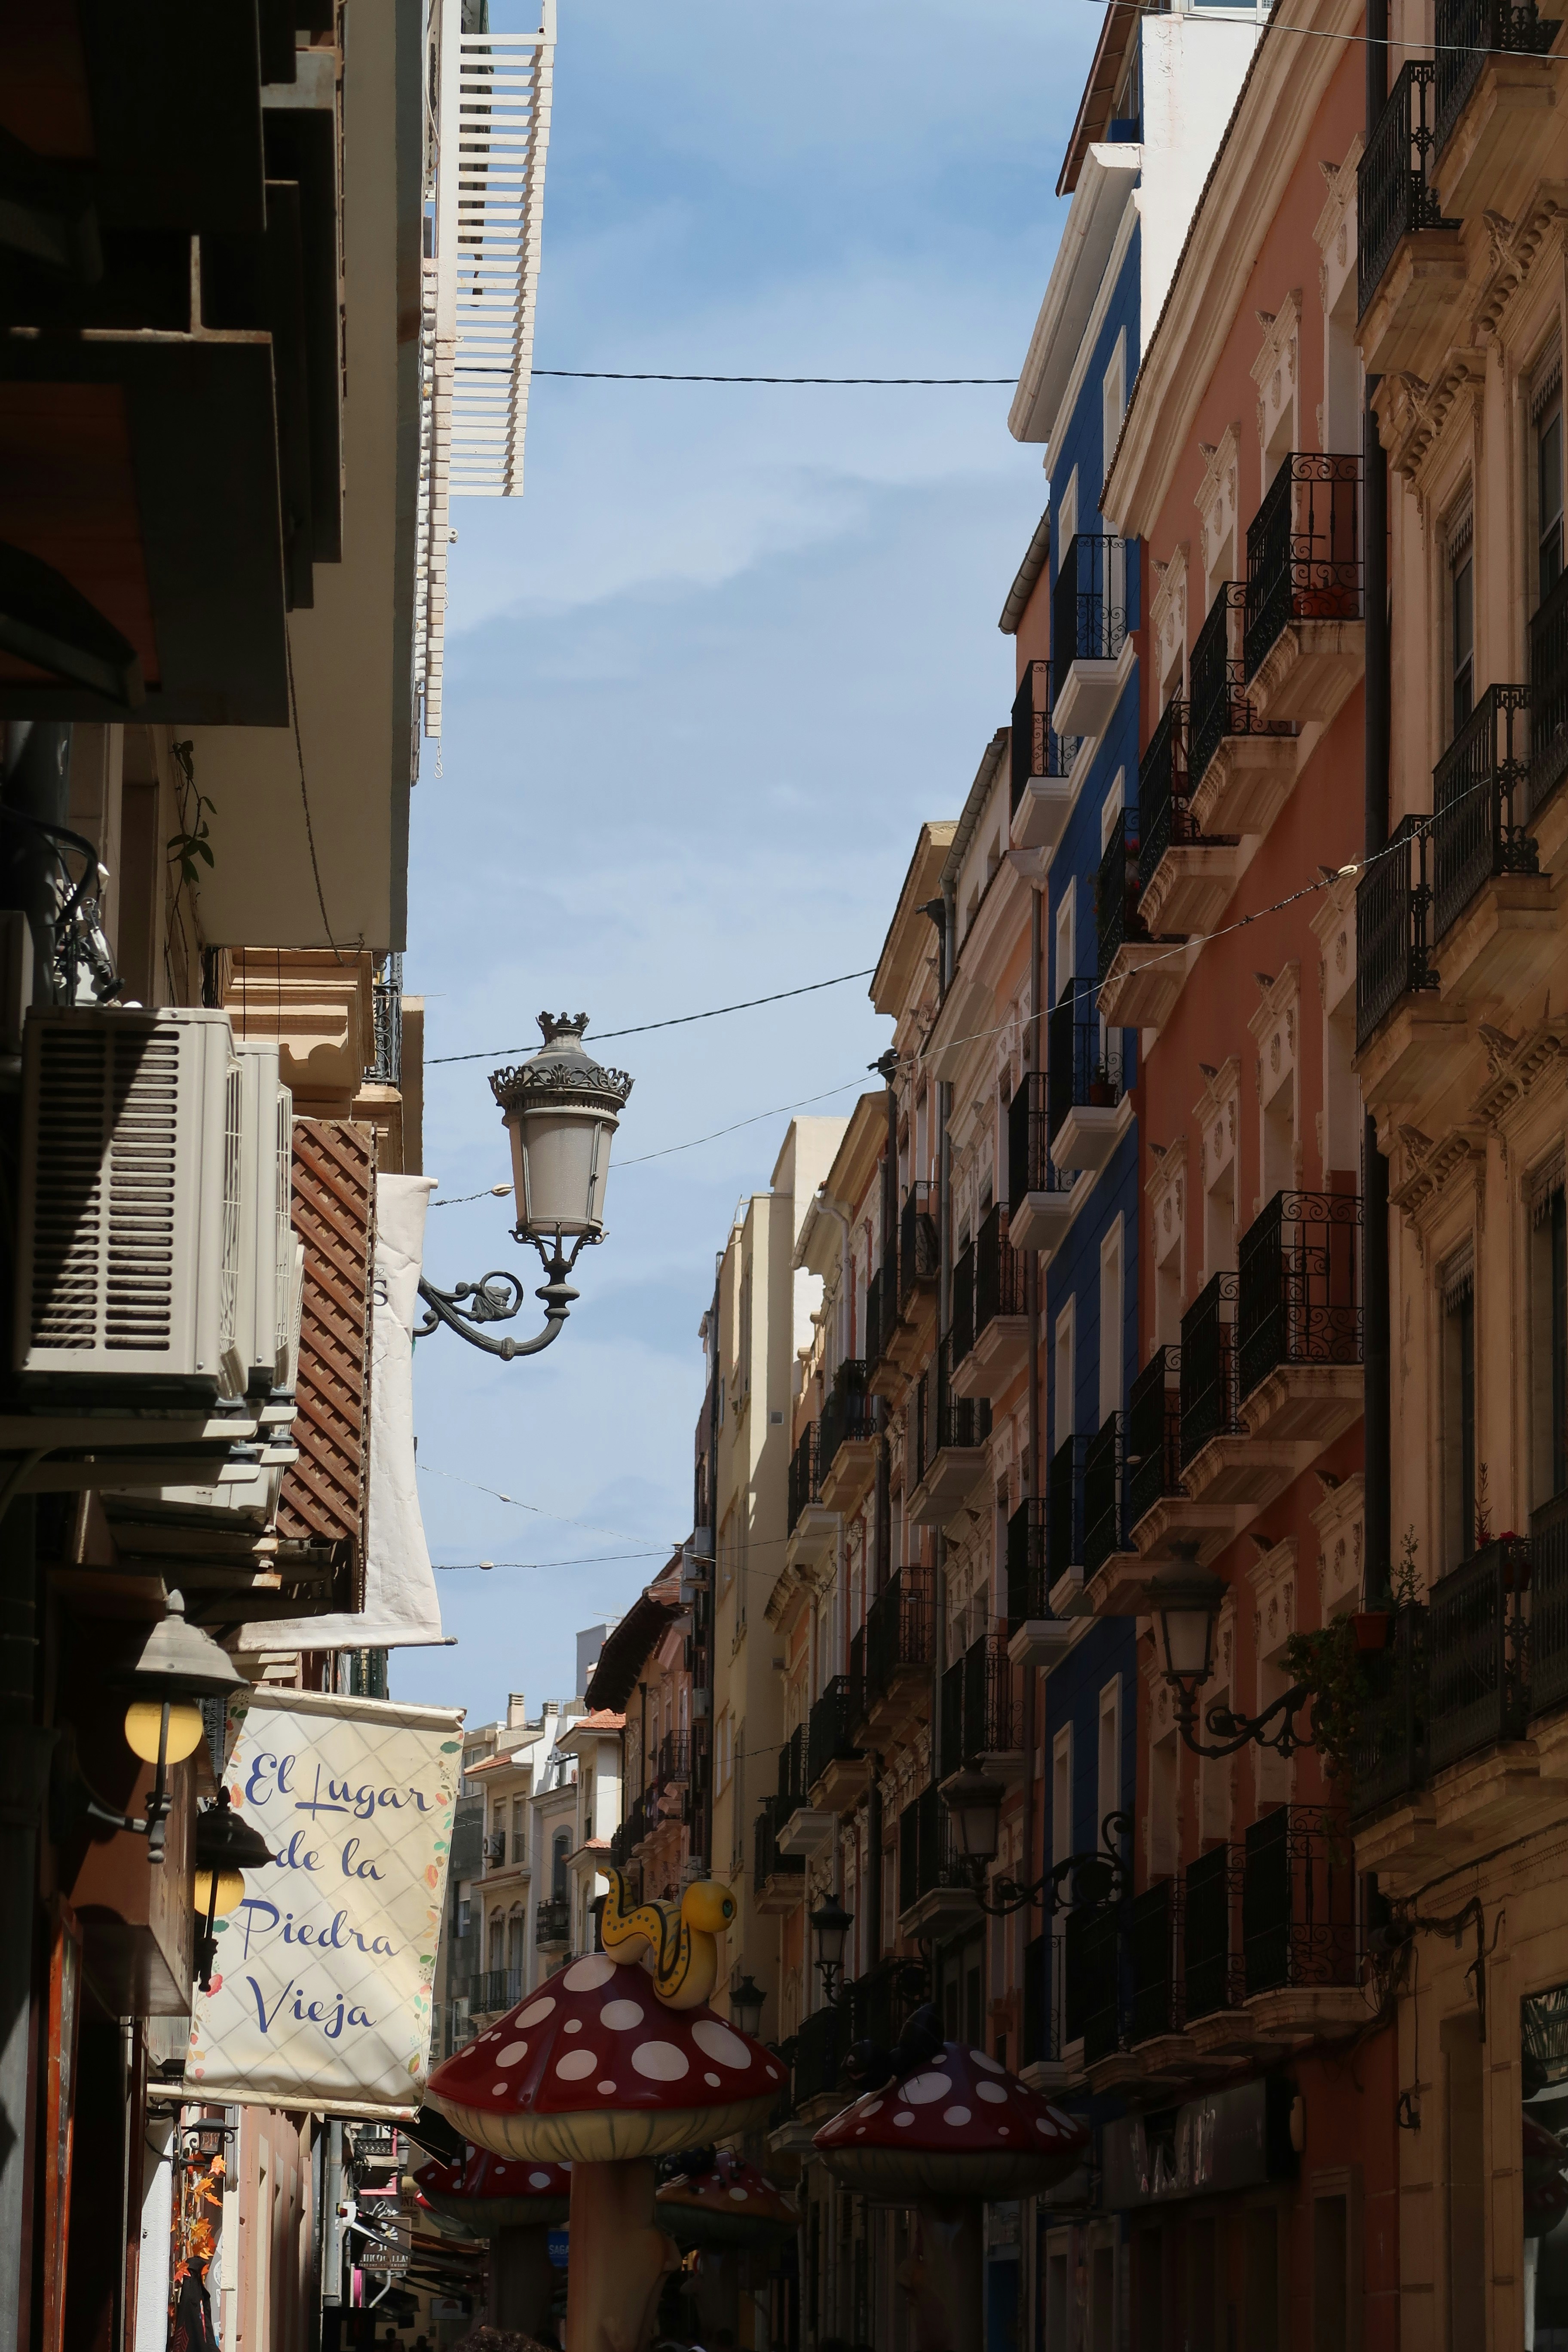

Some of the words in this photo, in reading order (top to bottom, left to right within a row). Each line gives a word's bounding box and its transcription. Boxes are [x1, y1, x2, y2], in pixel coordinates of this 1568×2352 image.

[245, 1753, 296, 1806] El
[295, 1764, 434, 1821] Lugar
[276, 1830, 325, 1871] de
[342, 1838, 386, 1881] la
[235, 1899, 399, 1960] Piedra
[246, 1976, 377, 2039] Vieja
